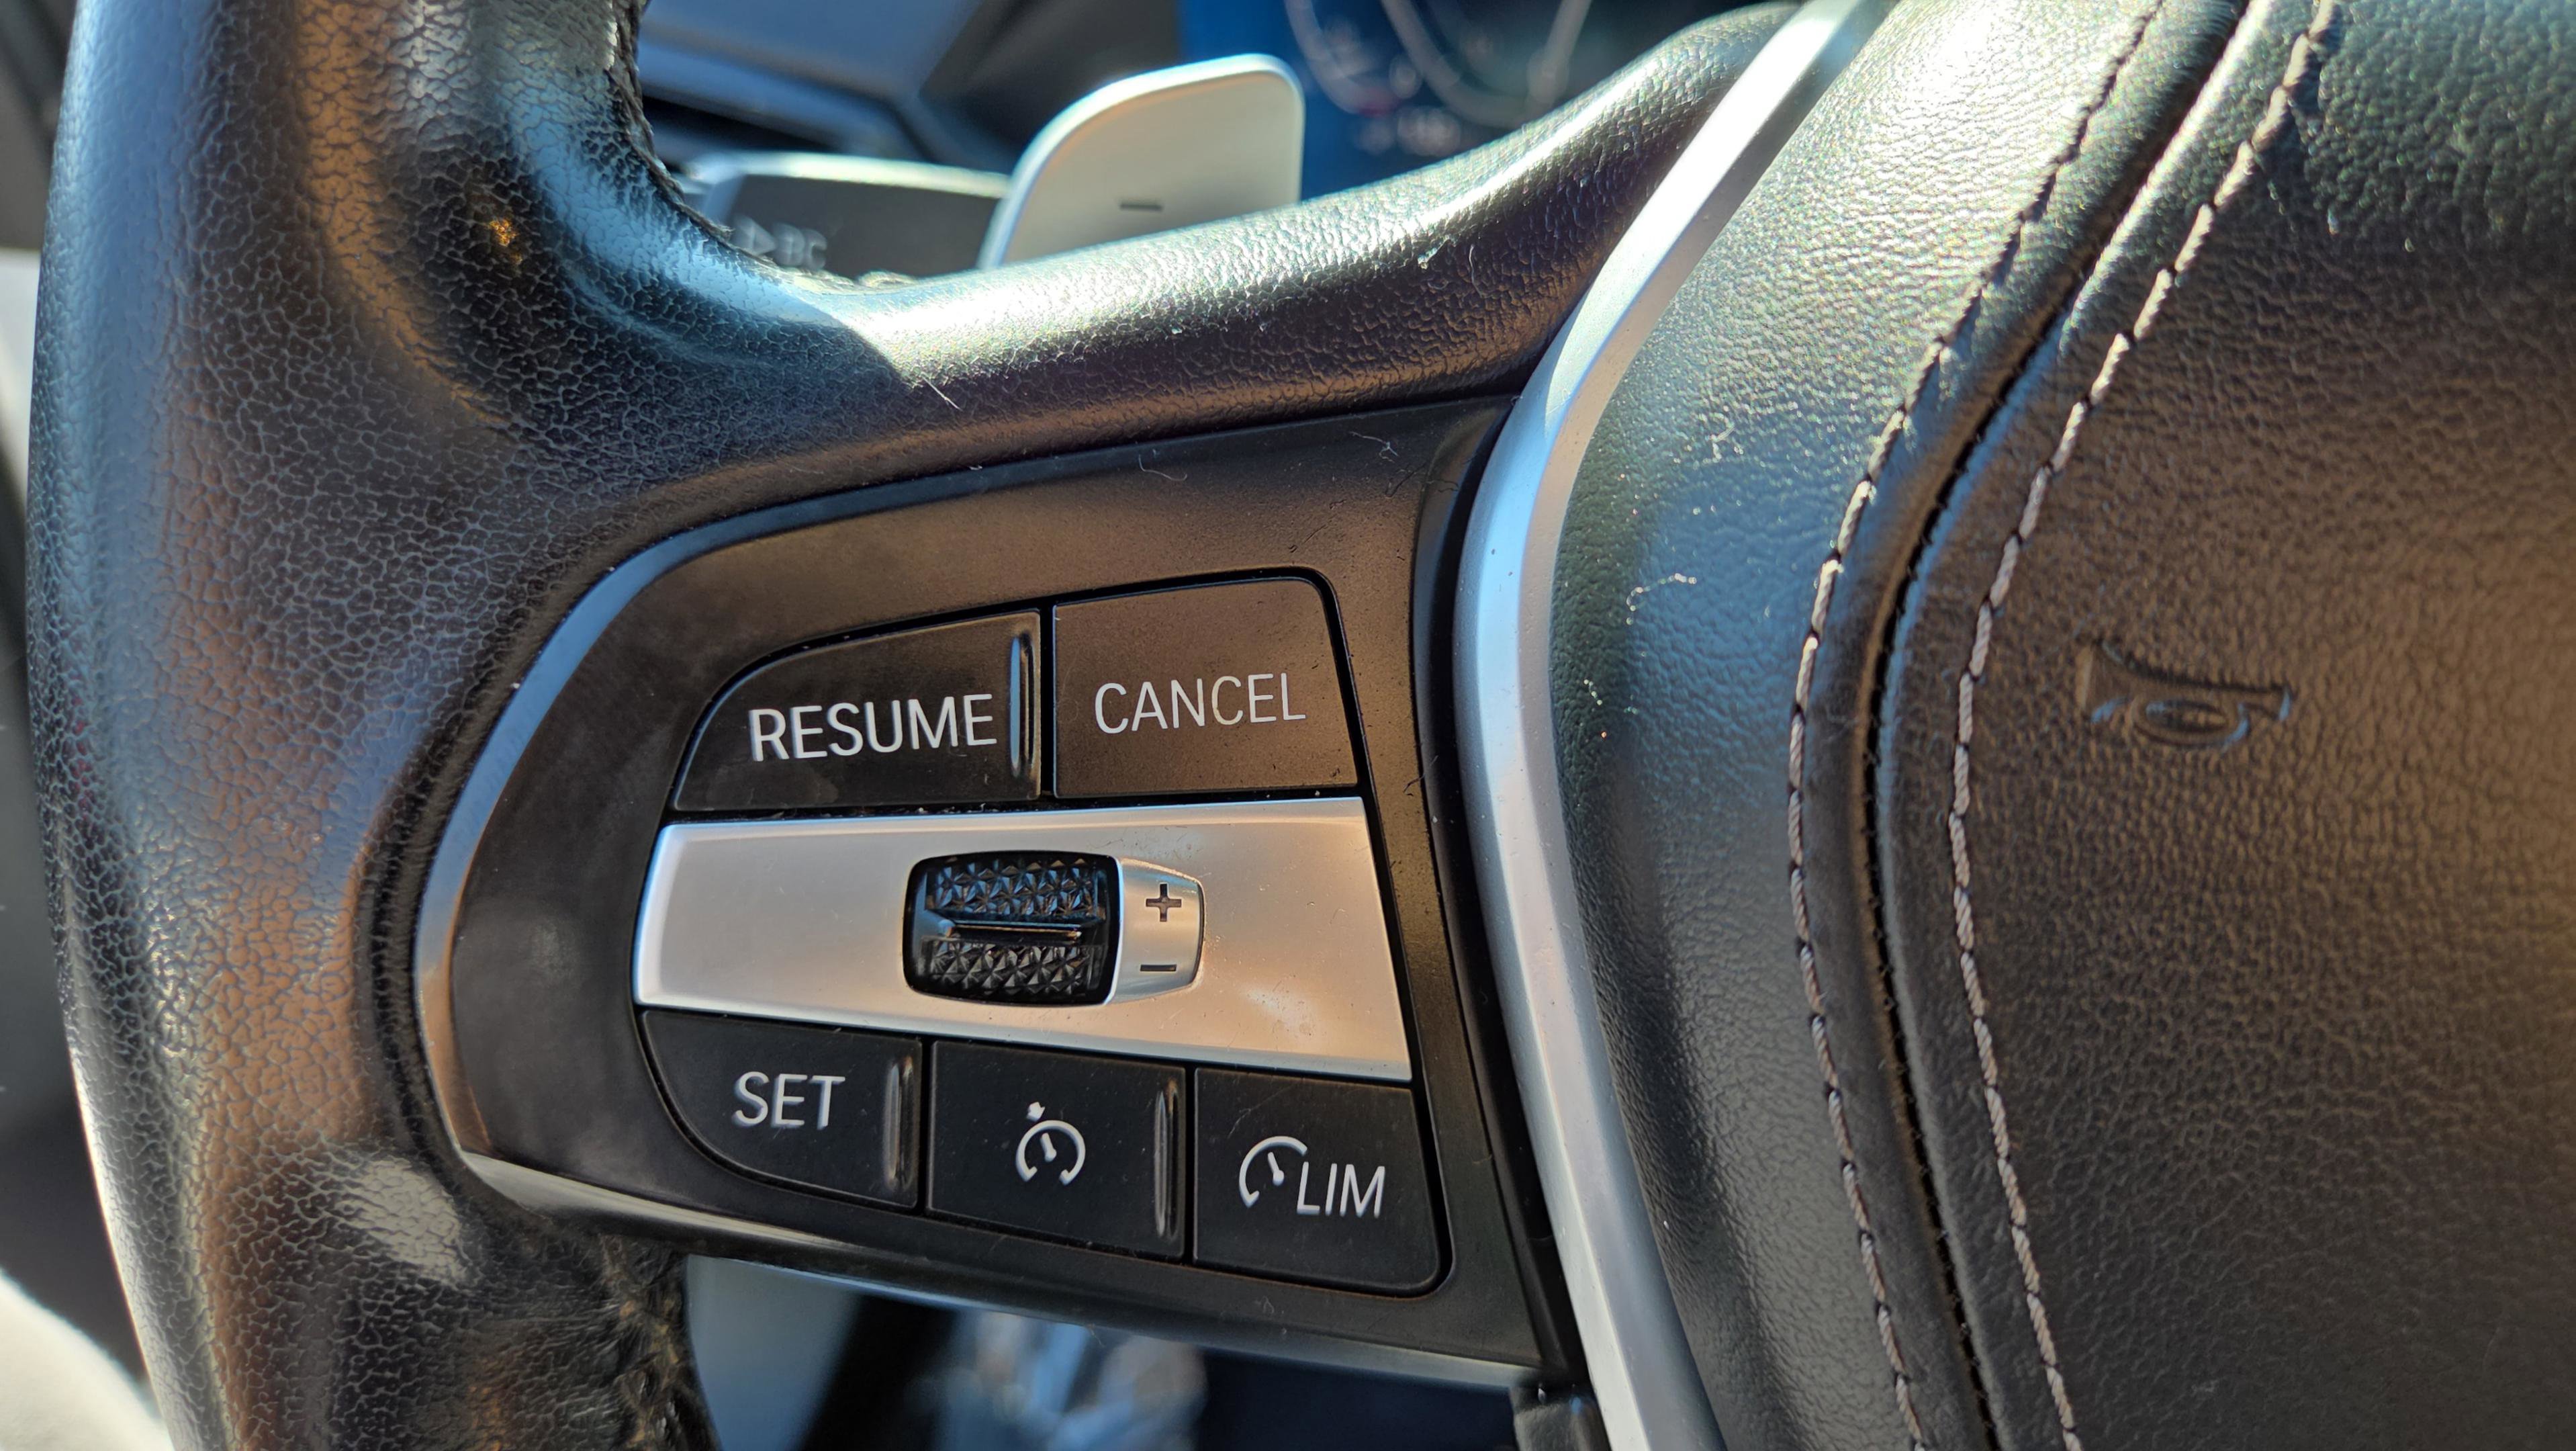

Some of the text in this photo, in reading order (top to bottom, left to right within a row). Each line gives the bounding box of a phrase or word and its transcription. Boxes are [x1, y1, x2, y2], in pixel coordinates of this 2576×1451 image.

[749, 693, 998, 762] RESUME
[1093, 672, 1307, 734] CANCEL
[733, 1071, 846, 1131] SET
[1295, 1161, 1386, 1218] LIM
